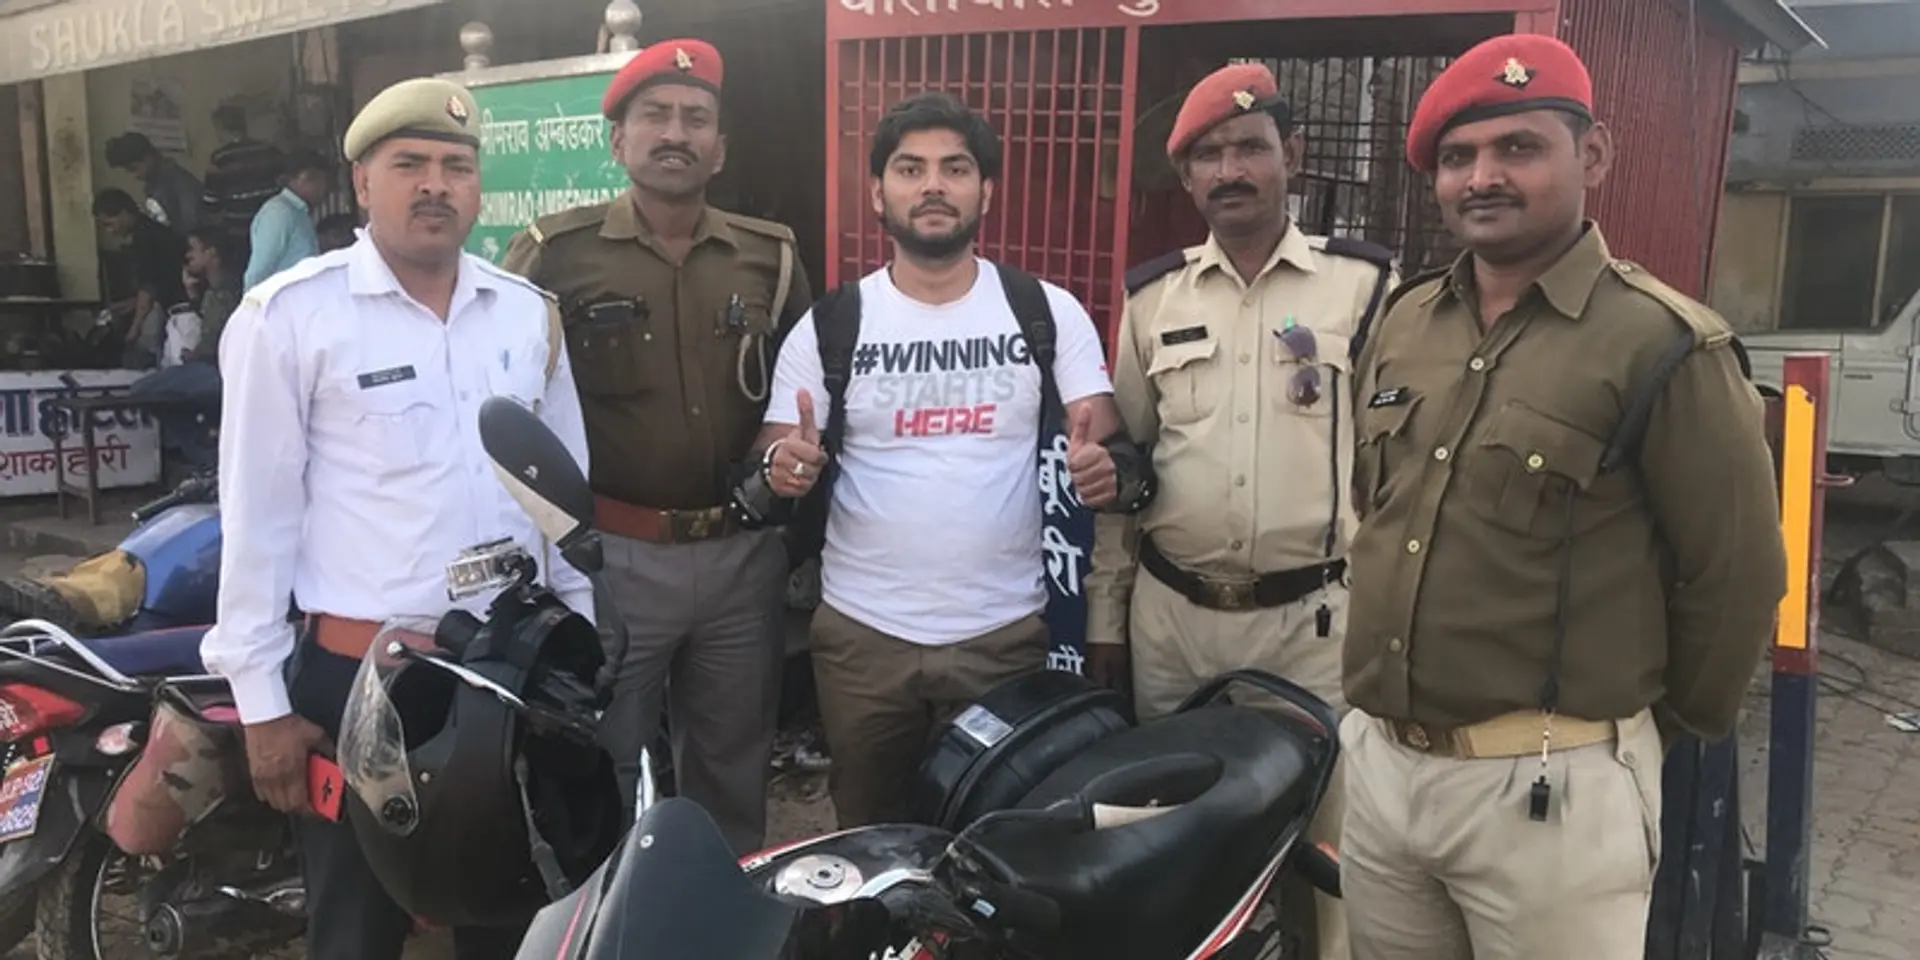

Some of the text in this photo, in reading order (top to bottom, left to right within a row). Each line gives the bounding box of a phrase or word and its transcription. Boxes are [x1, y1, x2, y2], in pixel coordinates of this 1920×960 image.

[29, 2, 187, 71] SHUKLA
[854, 333, 1031, 376] #WINNING
[872, 367, 1017, 410] STARTS
[894, 403, 997, 438] HERE
